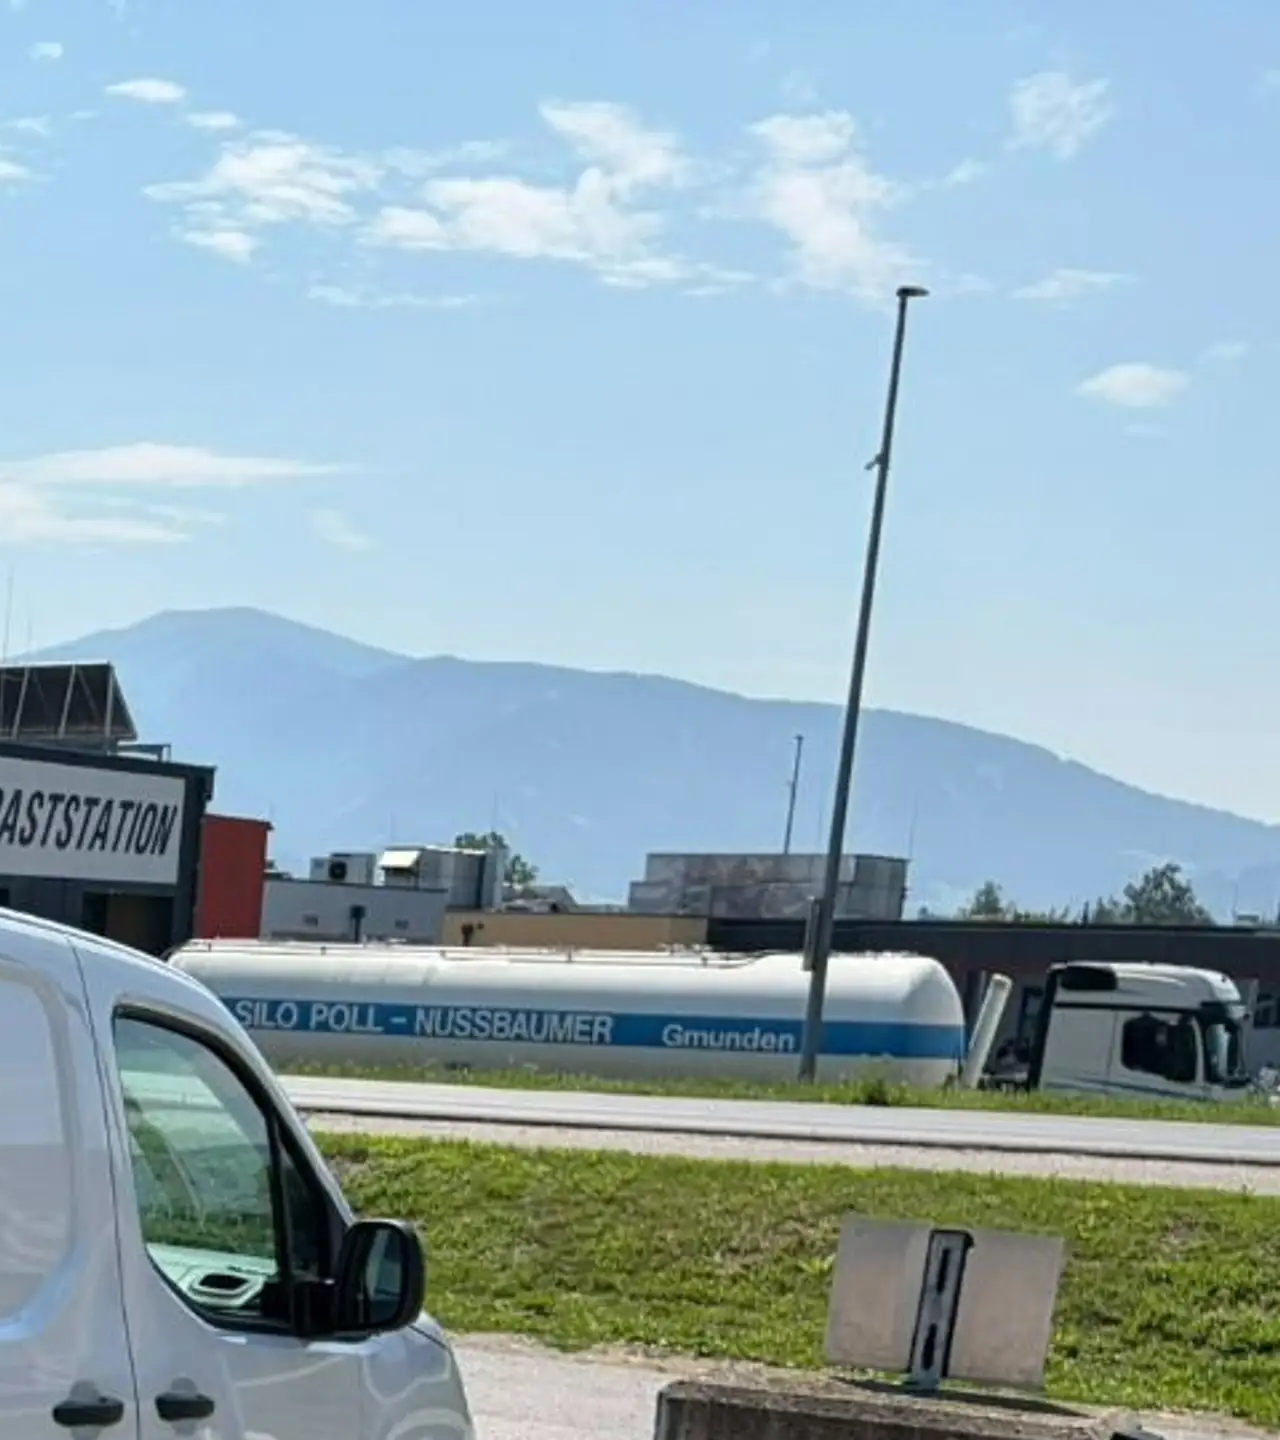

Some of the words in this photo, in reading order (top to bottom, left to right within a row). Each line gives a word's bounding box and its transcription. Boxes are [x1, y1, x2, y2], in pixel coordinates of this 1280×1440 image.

[235, 1000, 299, 1029] SILO
[309, 1003, 384, 1033] POLL
[414, 1007, 615, 1045] NUSSBAUMER
[661, 1022, 796, 1052] Gmunden
